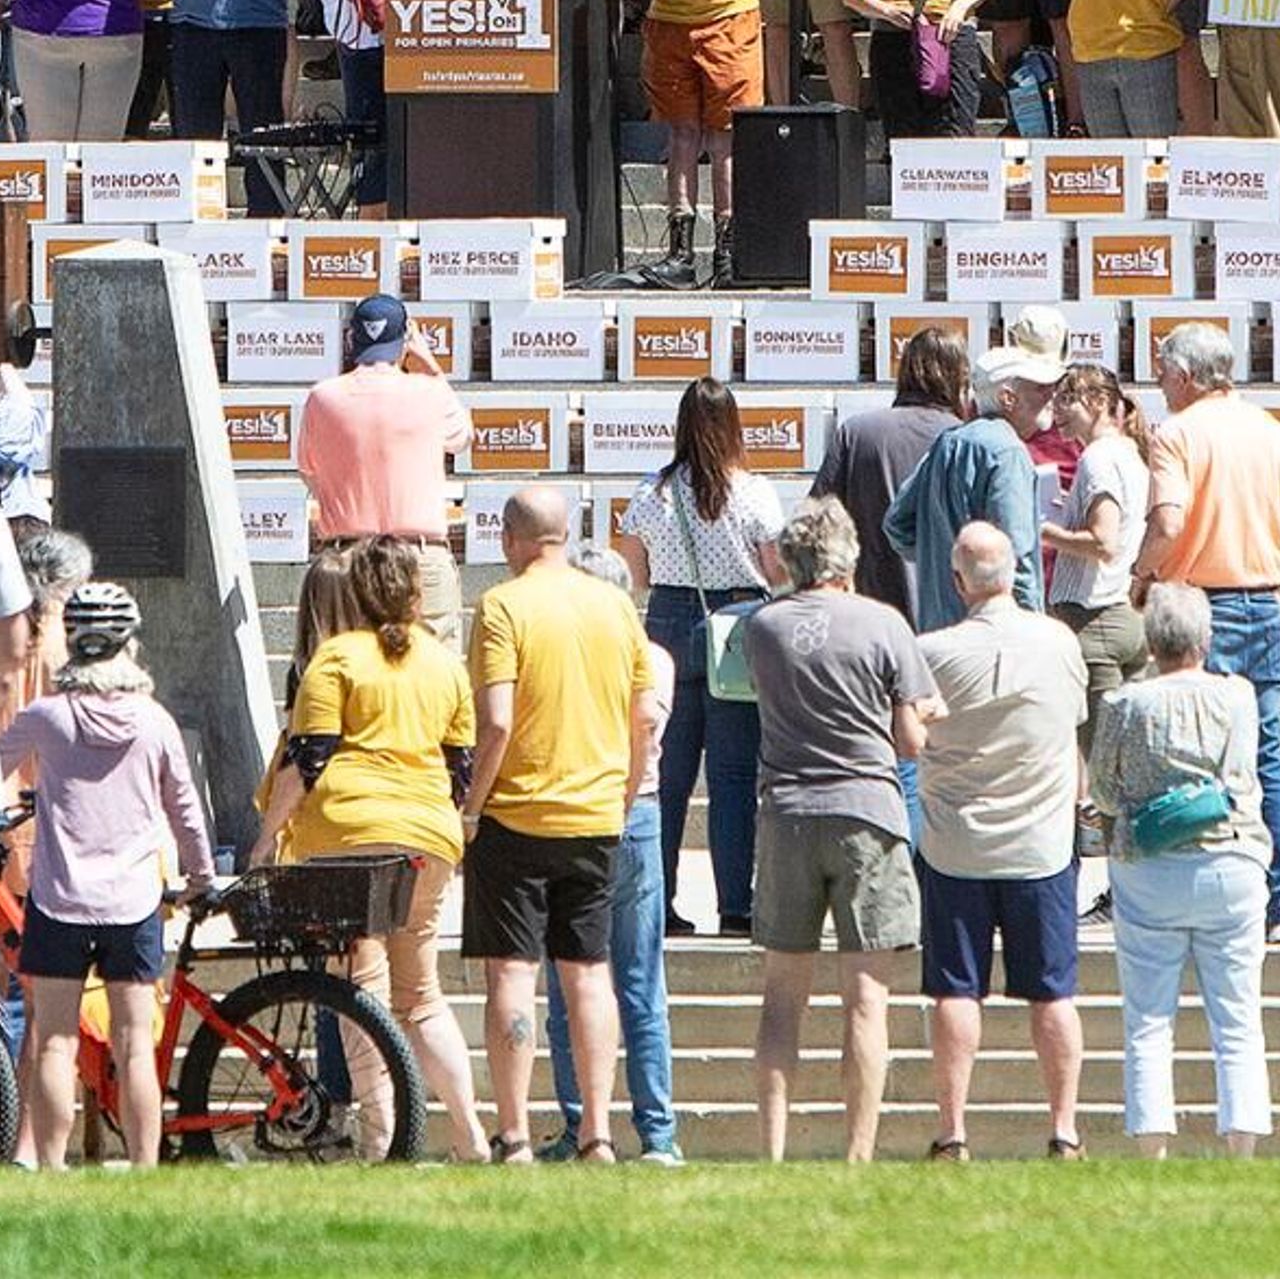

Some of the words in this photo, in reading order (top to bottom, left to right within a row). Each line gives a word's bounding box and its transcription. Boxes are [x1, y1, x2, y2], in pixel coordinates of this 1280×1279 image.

[390, 0, 486, 33] YES!
[493, 16, 516, 28] ON
[395, 37, 417, 48] FOR
[421, 37, 452, 48] OPEN
[455, 37, 514, 49] PRIMARIES
[90, 172, 181, 188] MINIDOKA
[900, 169, 989, 181] CLEARWATER
[1049, 172, 1090, 188] YES!
[1181, 171, 1266, 188] ELMORE
[428, 250, 462, 267] NEZ
[465, 250, 522, 268] PERCE
[956, 253, 1048, 267] BINGHAM
[1096, 253, 1136, 269] YES!
[235, 331, 275, 347] BEAR
[278, 331, 325, 347] LAKE
[511, 331, 578, 349] IDAHO
[752, 329, 846, 346] BONNEVILLE
